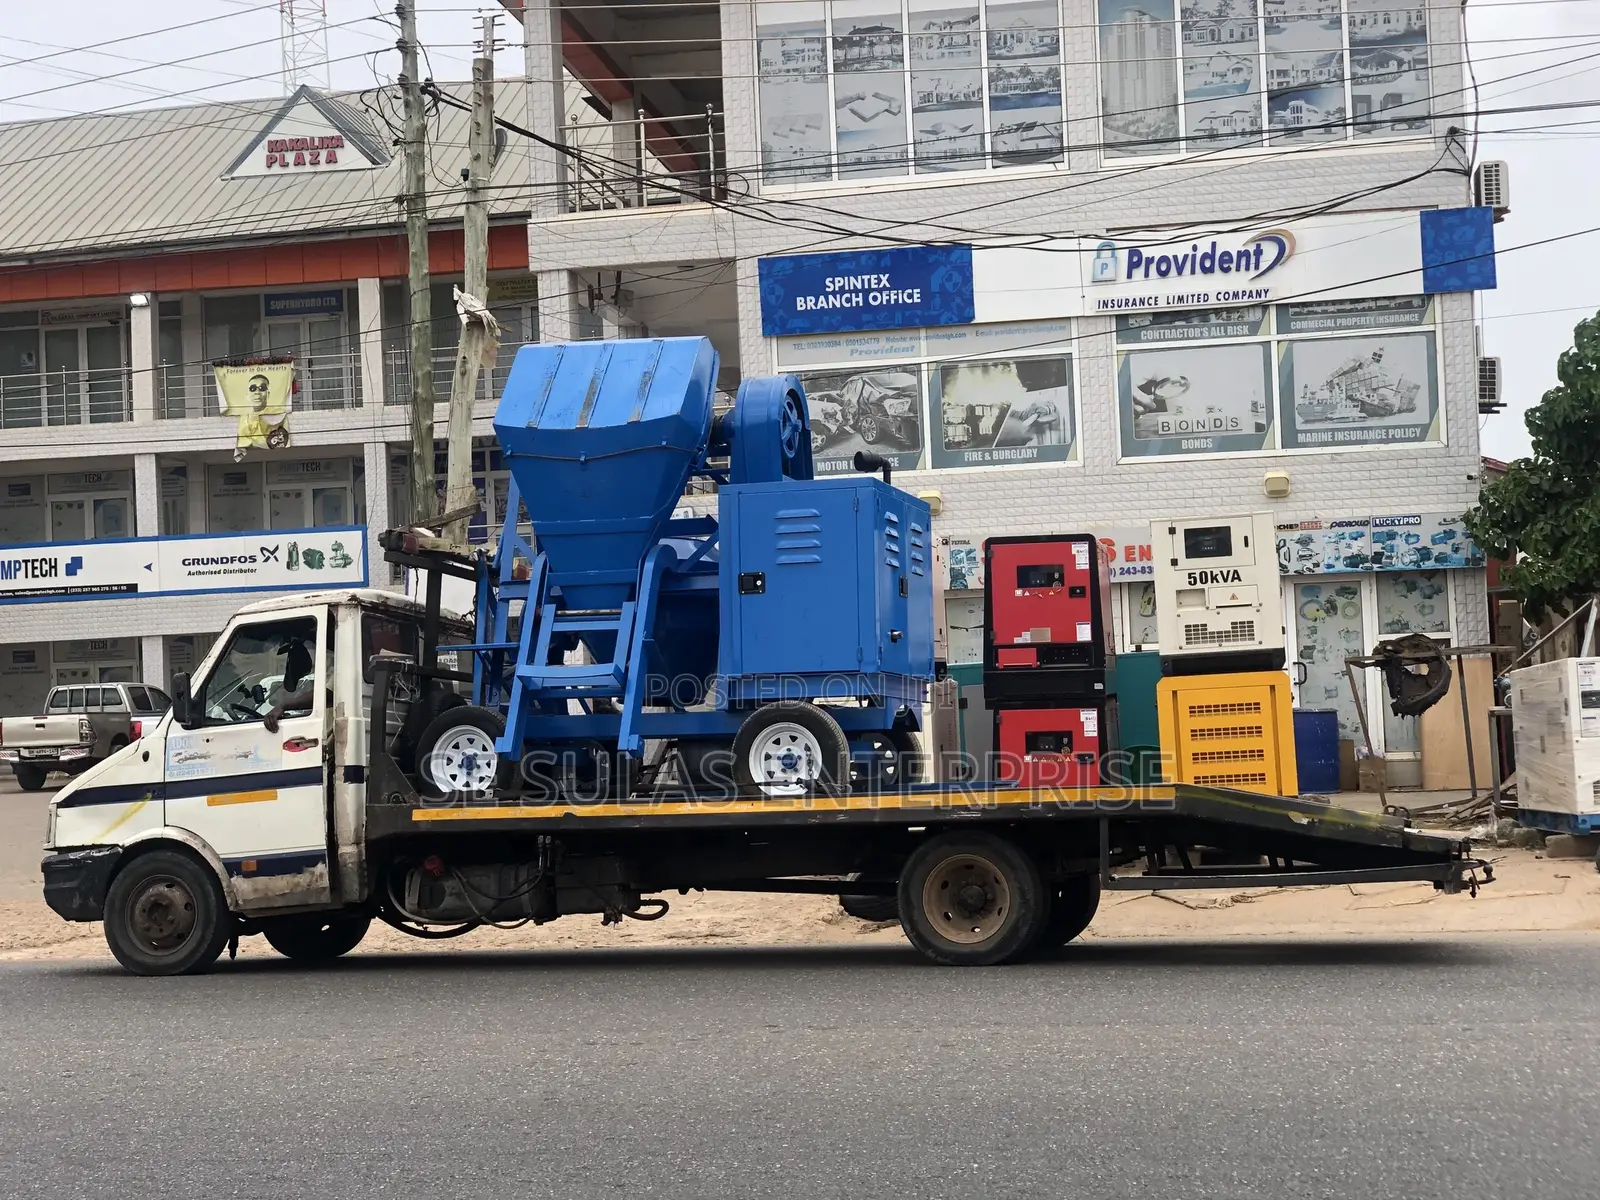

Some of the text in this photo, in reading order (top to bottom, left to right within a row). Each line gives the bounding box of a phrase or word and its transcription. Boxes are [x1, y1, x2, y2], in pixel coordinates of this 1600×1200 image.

[267, 135, 344, 153] KAKALIKA
[266, 150, 338, 168] PLAZA
[1127, 241, 1264, 280] Provident
[825, 273, 891, 292] SPINTEX
[796, 288, 921, 311] BRANCH OFFICE
[1097, 288, 1270, 310] INSURANCE LIMITED COMPANY
[1290, 313, 1420, 330] COMMECIAL PROPERTY INSURANCE
[1140, 324, 1250, 340] CONTRACTOR'S ALL RISK
[850, 345, 915, 356] Provident
[1297, 427, 1421, 443] MARINE INSURANCE POLICY
[1181, 438, 1213, 450] BONDS
[964, 448, 1038, 462] FIRE & BURGLARY
[816, 460, 848, 472] MOTOR
[1329, 519, 1370, 530] PEDROLLO
[181, 554, 257, 567] GRUNDFOS
[1124, 544, 1153, 562] EN
[187, 567, 257, 577] Authorised Distributor
[1119, 565, 1154, 576] 243-83
[1187, 569, 1243, 587] 50kVA
